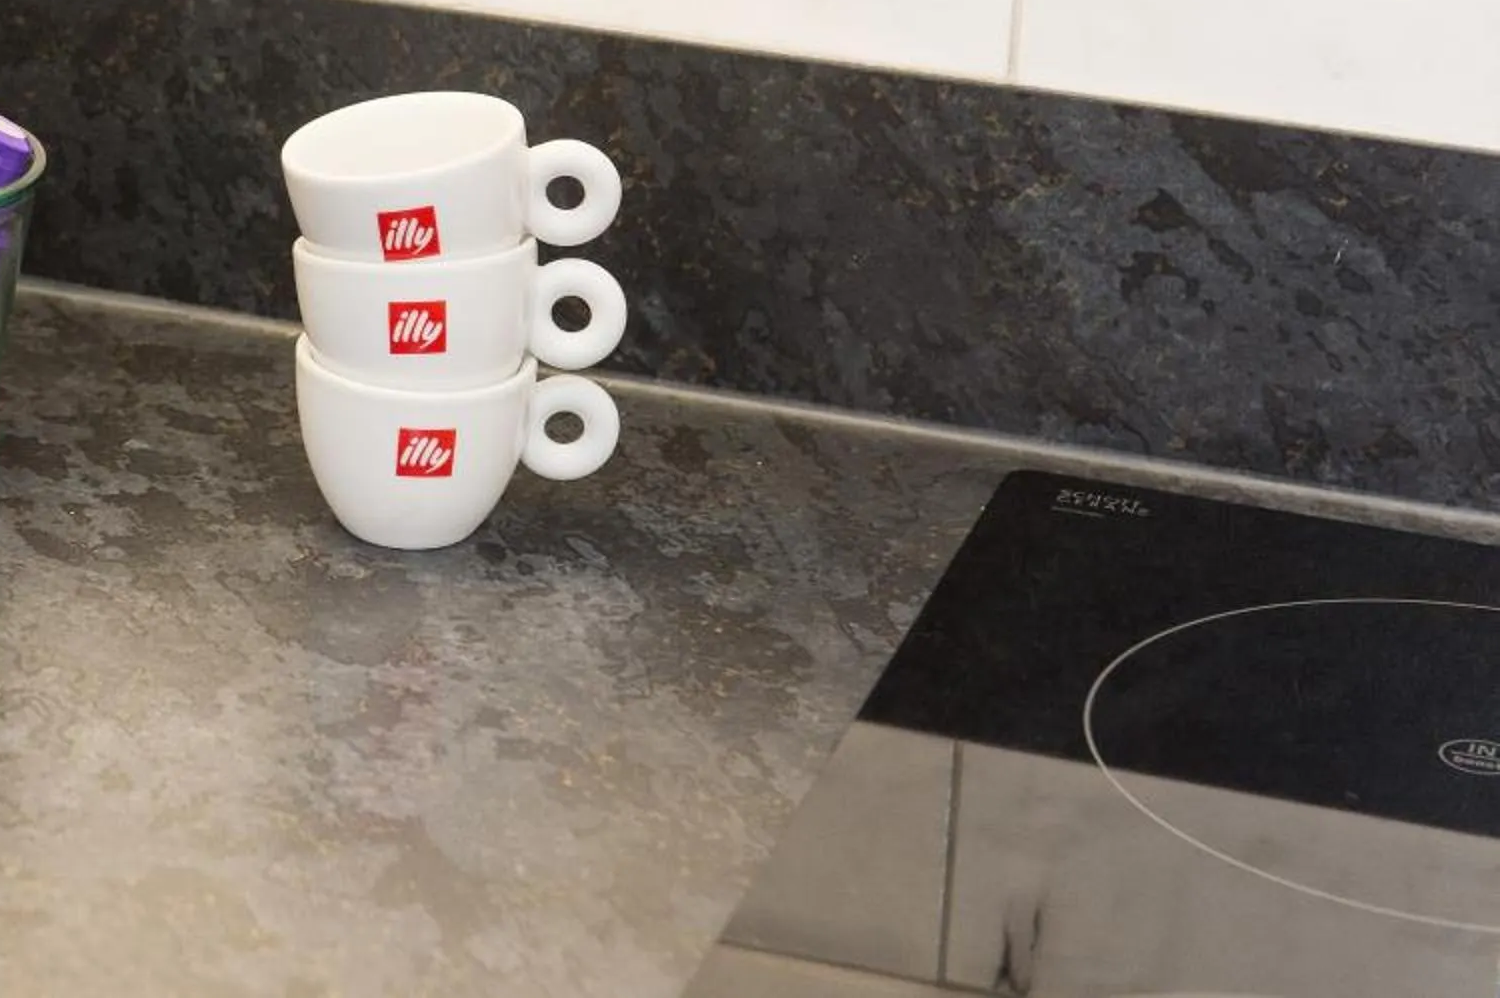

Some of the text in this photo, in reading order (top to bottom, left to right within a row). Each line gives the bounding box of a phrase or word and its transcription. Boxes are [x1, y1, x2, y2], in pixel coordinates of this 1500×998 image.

[386, 218, 434, 254] illy
[393, 310, 443, 348] illy
[400, 437, 452, 473] illy
